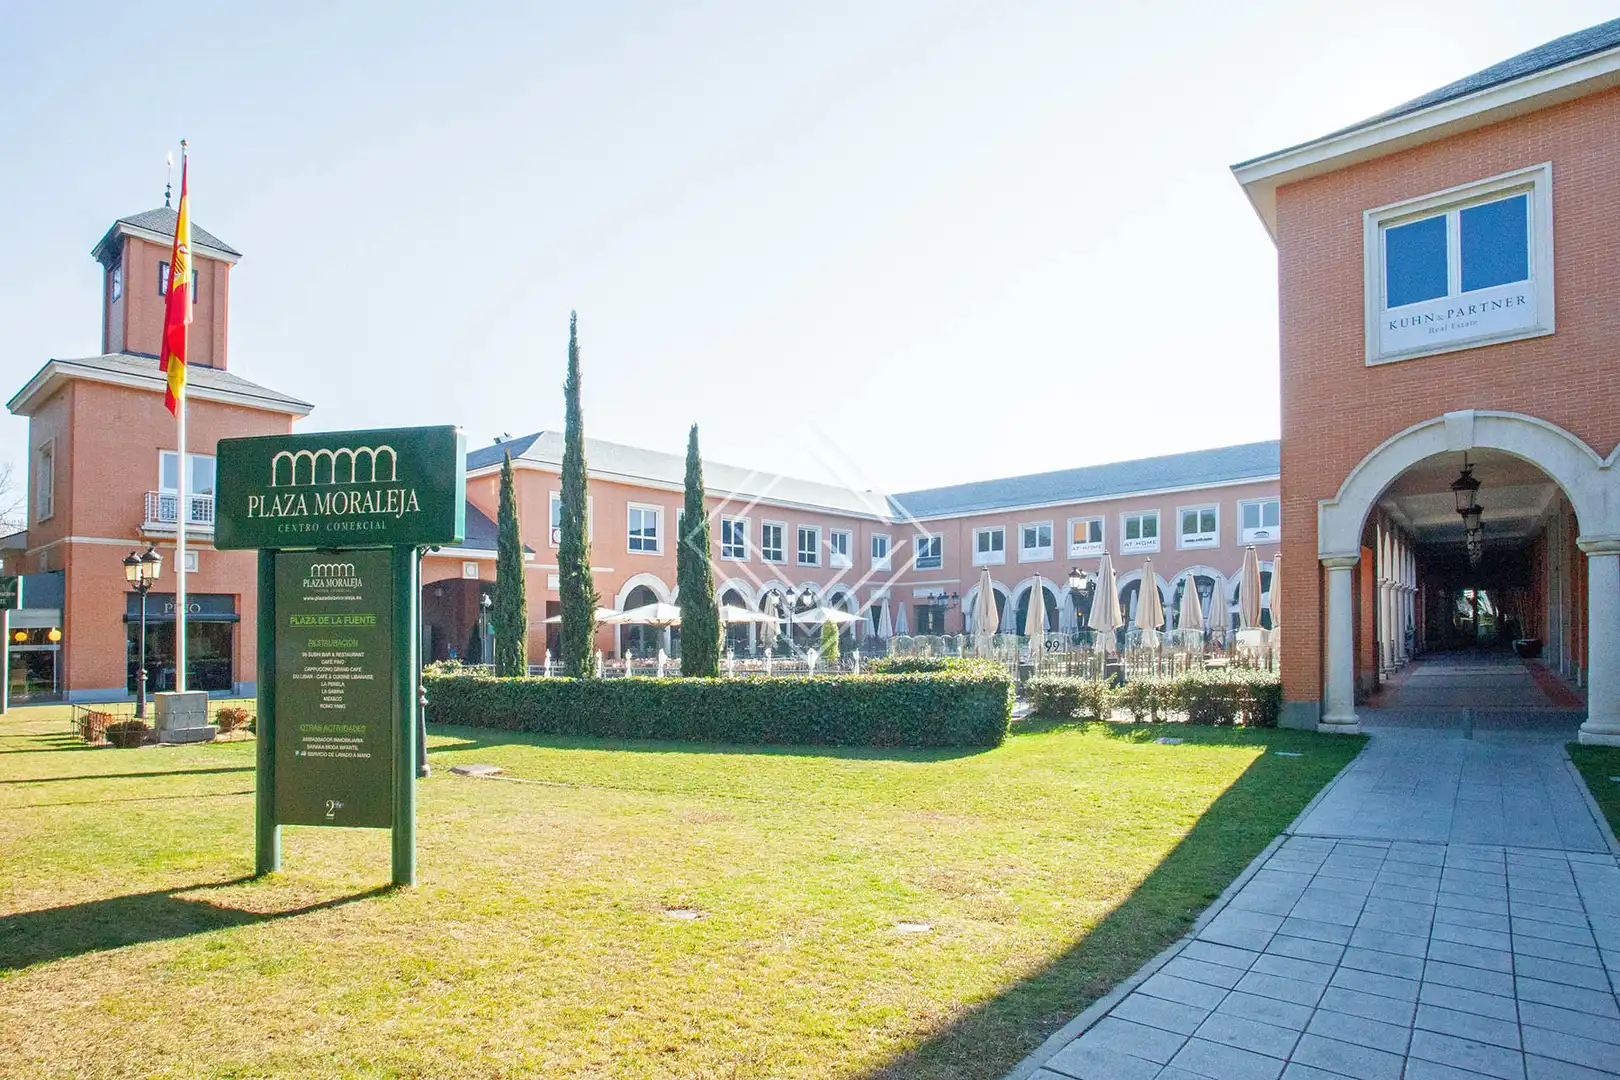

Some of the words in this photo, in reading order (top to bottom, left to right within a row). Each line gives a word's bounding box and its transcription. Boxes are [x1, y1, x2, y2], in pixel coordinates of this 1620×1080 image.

[1389, 312, 1435, 331] KUHN
[1447, 295, 1526, 319] PARTNER
[1428, 325, 1448, 334] Real
[1451, 319, 1479, 331] Estate
[247, 492, 309, 518] PLAZA
[313, 488, 421, 518] MORALEJA
[278, 522, 320, 533] CENTRO
[326, 520, 387, 531] COMERCIAL
[303, 578, 325, 588] PLAZA
[326, 577, 363, 589] MORALEJA
[290, 616, 317, 625] PLAZA
[319, 616, 329, 624] DE
[331, 616, 343, 625] LA
[344, 616, 377, 624] FUENTE
[1045, 640, 1060, 652] 99
